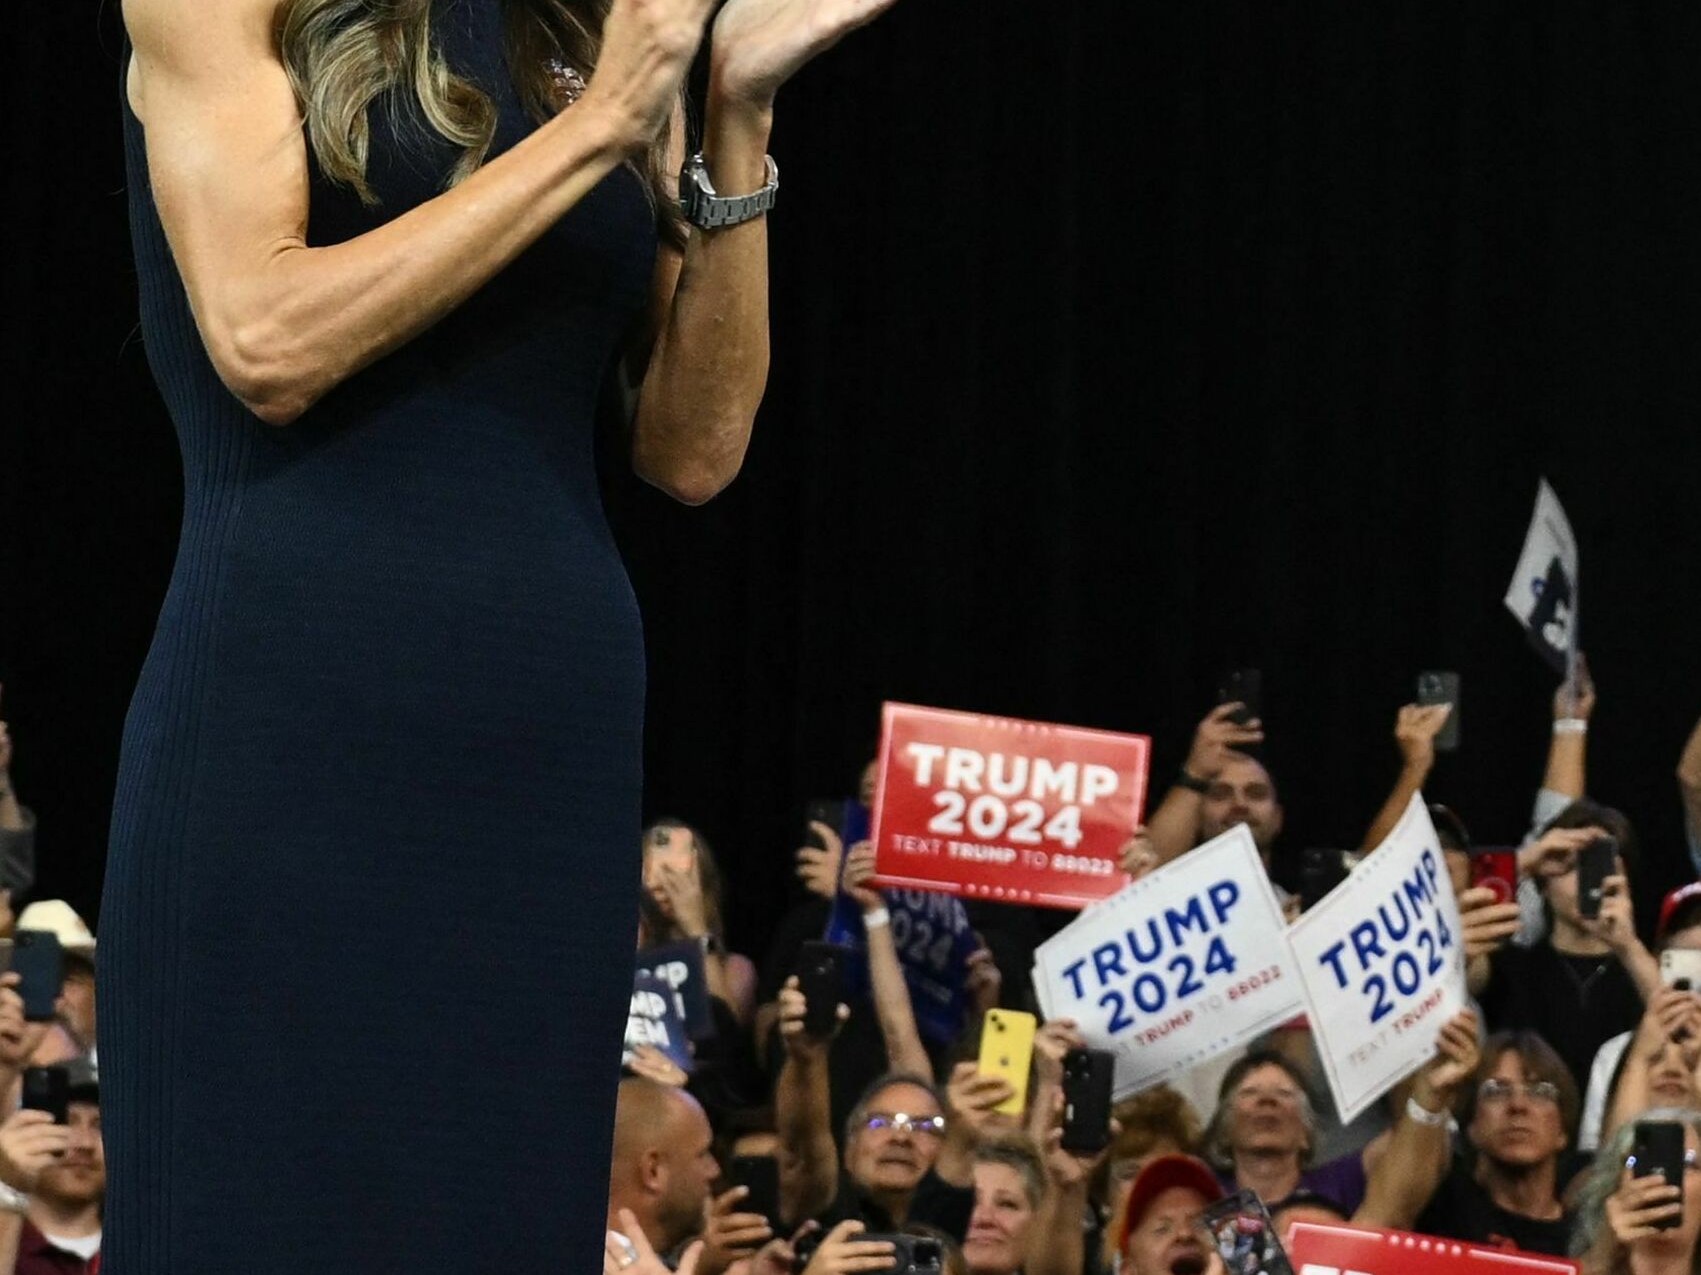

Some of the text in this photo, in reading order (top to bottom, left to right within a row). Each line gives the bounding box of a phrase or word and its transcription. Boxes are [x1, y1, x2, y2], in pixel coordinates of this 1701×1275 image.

[906, 741, 1120, 807] TRUMP
[892, 832, 943, 857] TEXT
[947, 840, 1018, 865] TRUMP
[1021, 848, 1049, 871] TO
[927, 789, 1084, 849] 2024
[1062, 879, 1240, 1000] TRUMP
[1320, 847, 1439, 989] TRUMP
[1099, 935, 1237, 1035] 2024
[1362, 908, 1453, 1024] 2024
[1134, 1009, 1195, 1047] TRUMP
[1347, 986, 1445, 1066] TEXT TRUMP
